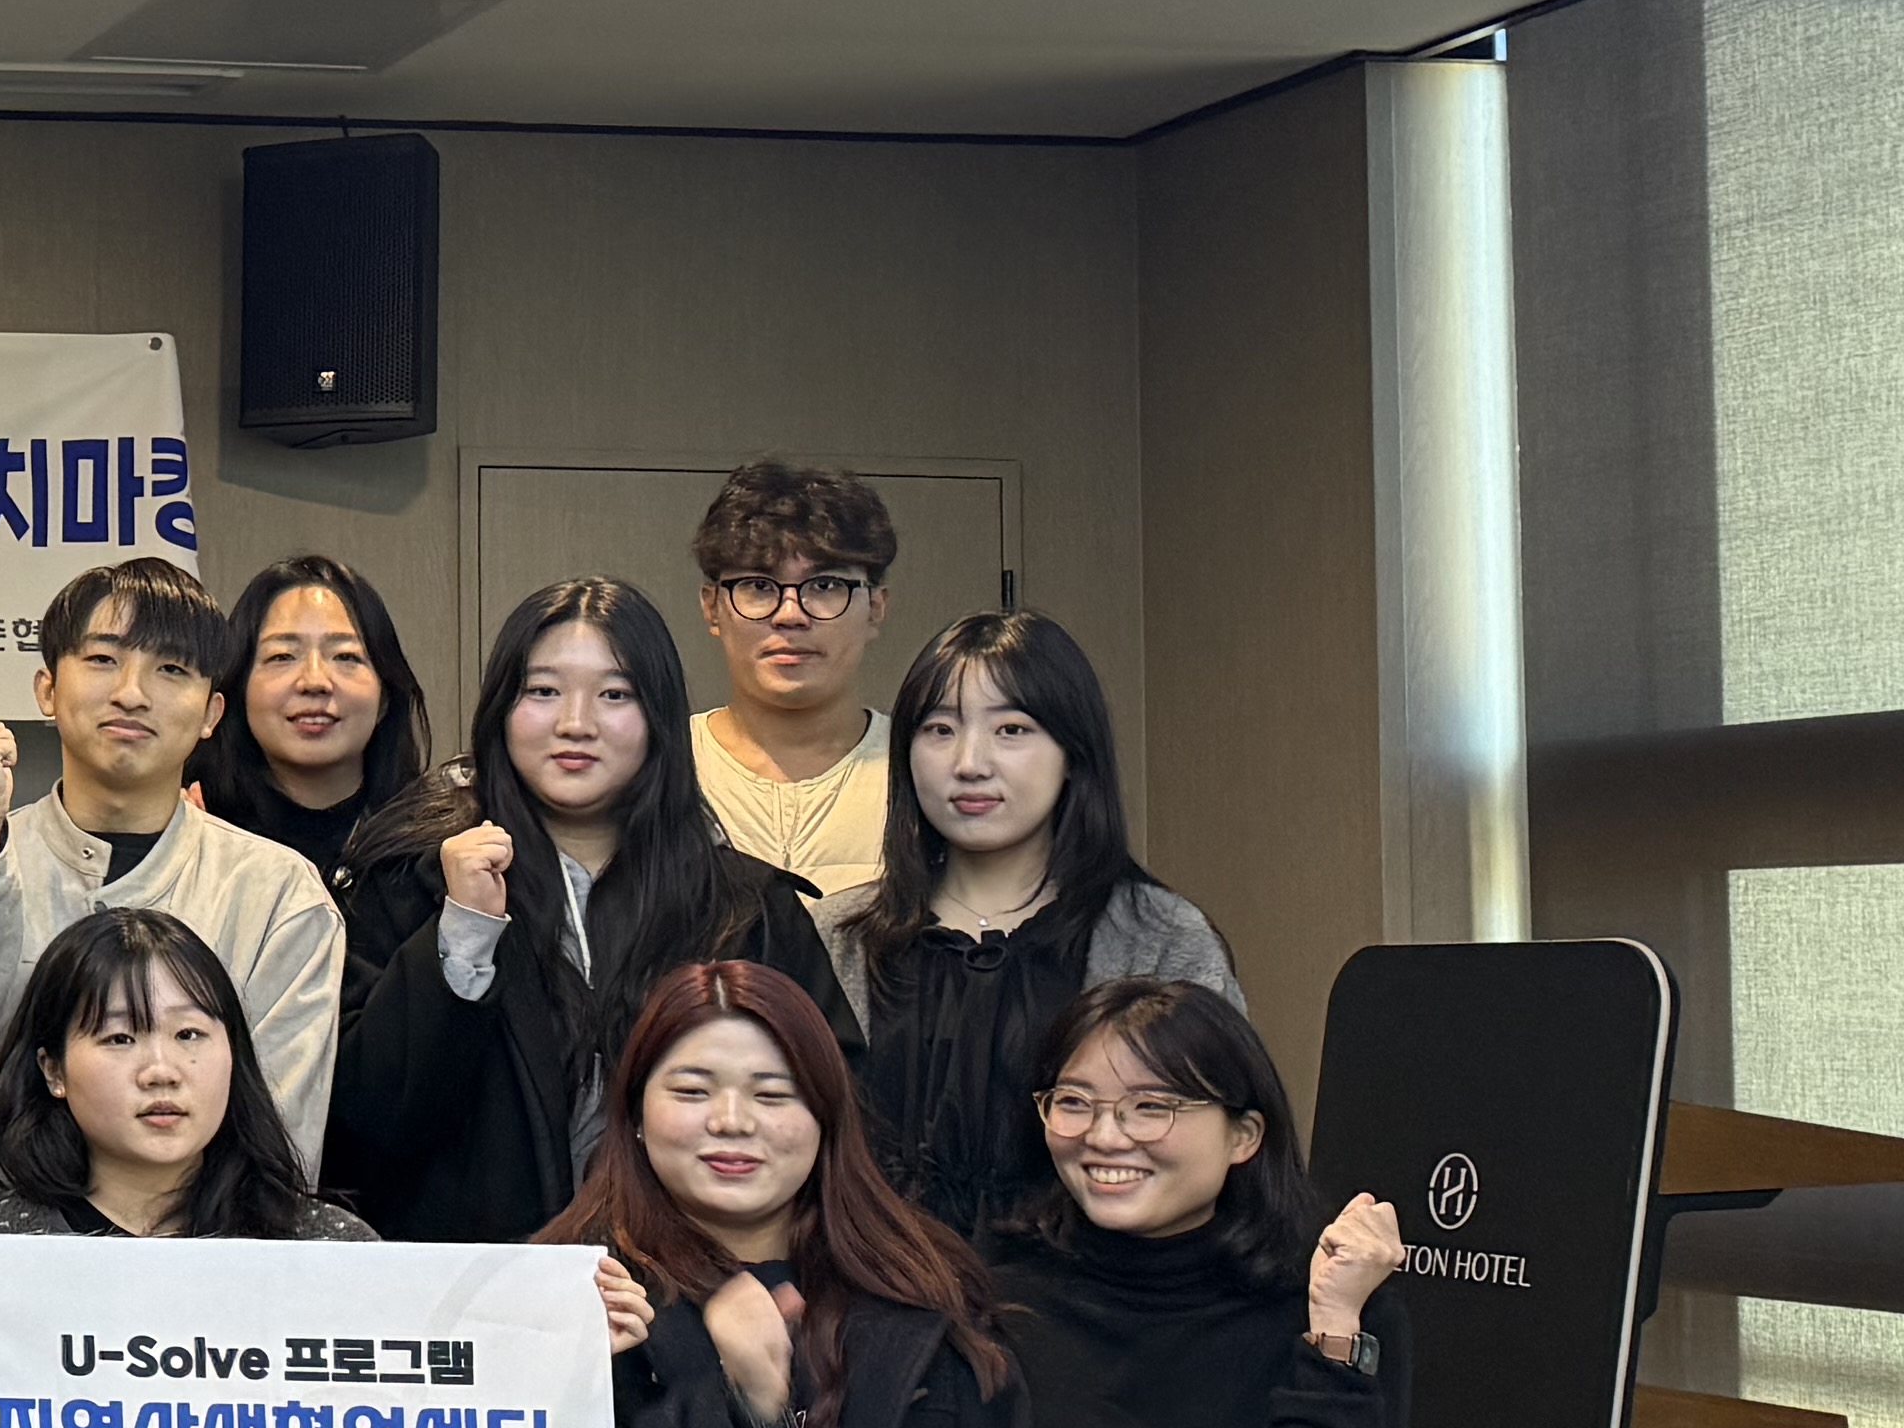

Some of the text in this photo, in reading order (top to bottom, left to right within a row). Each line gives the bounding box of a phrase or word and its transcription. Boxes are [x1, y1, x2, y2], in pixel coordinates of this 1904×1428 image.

[1394, 1244, 1532, 1288] TON HOTEL
[60, 1333, 475, 1385] U-Solve 프로그램
